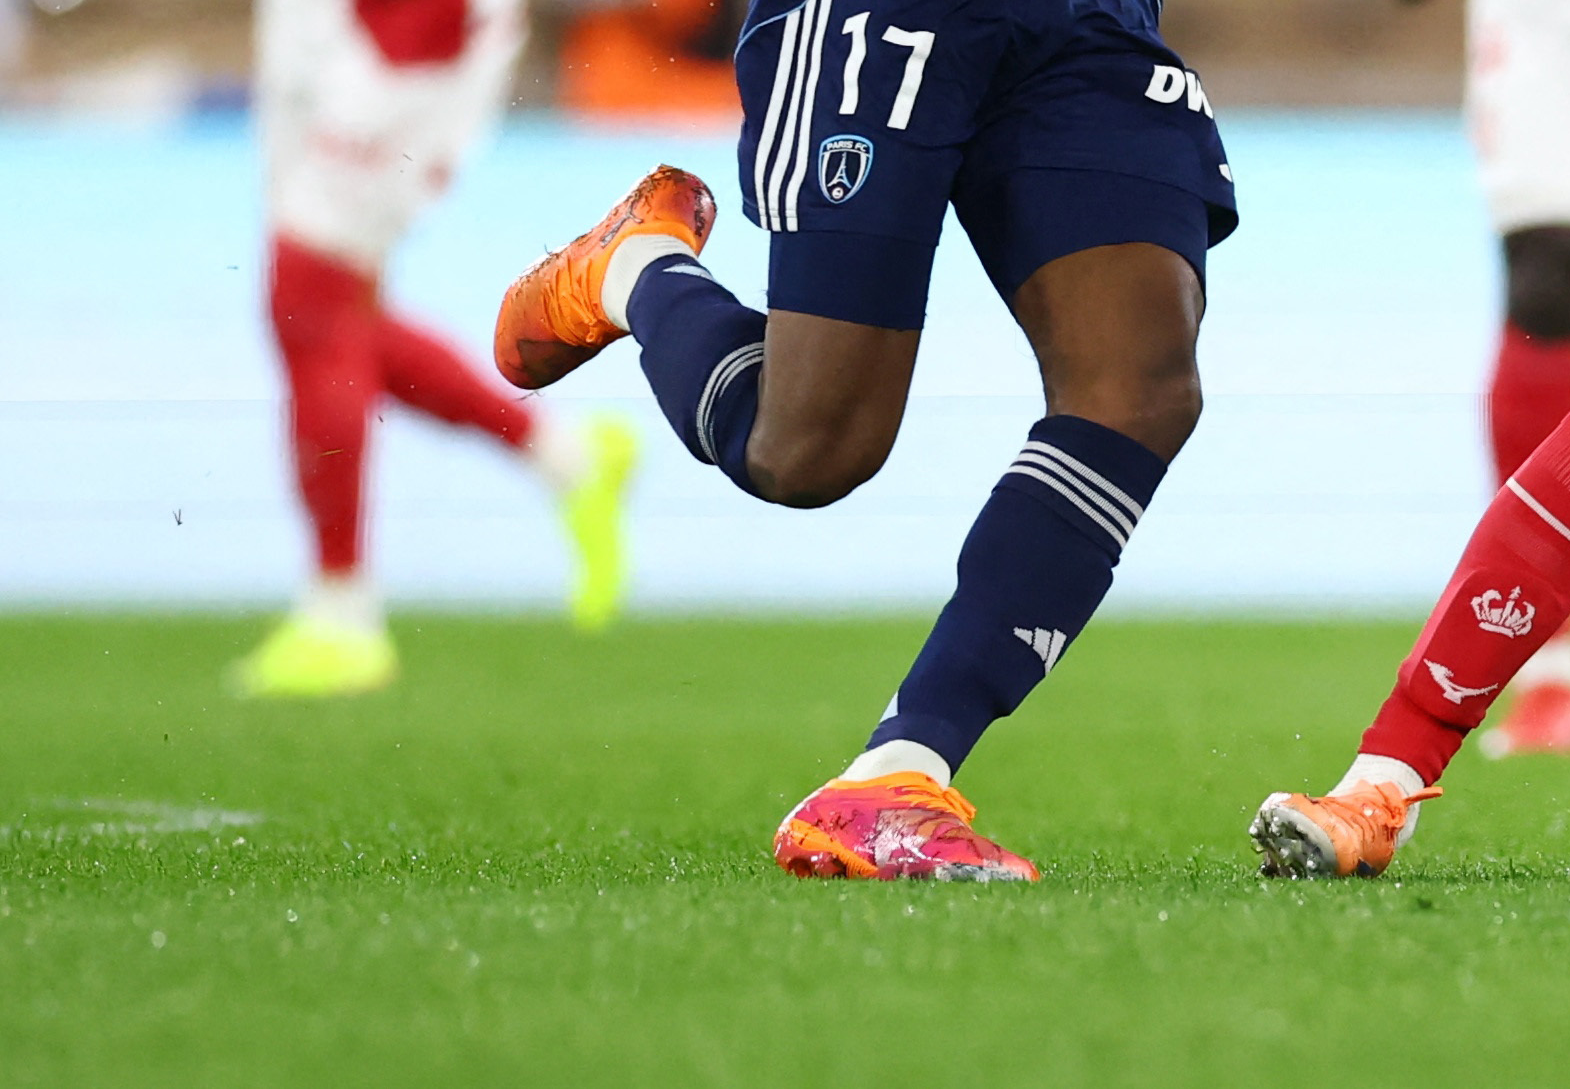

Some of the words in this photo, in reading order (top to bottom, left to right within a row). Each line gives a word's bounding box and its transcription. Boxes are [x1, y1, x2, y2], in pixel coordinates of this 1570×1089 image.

[838, 11, 936, 130] 17
[826, 141, 854, 151] PARIS
[855, 142, 868, 152] FC
